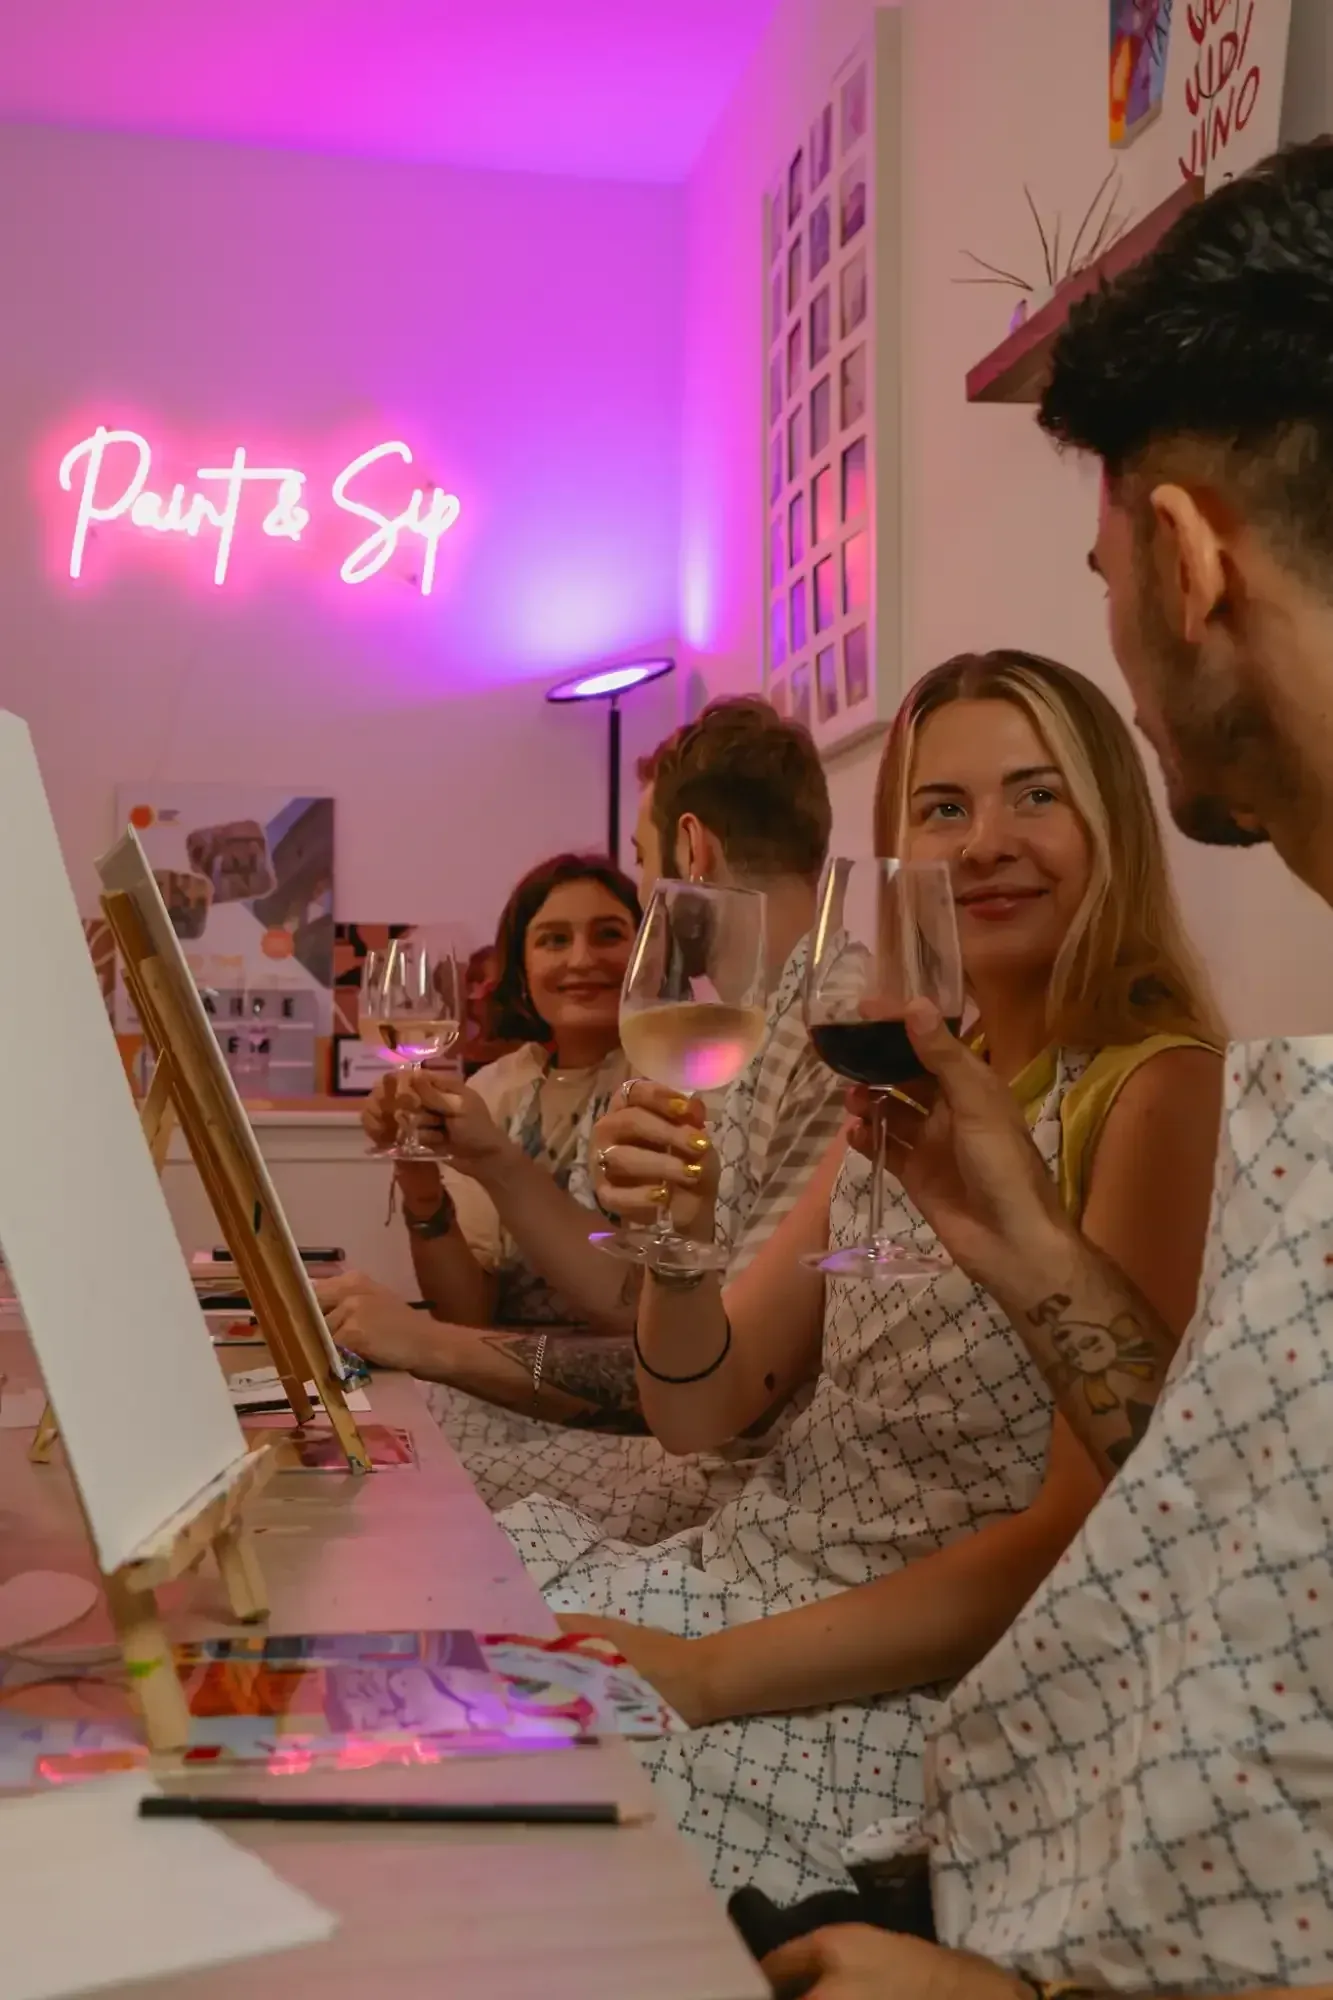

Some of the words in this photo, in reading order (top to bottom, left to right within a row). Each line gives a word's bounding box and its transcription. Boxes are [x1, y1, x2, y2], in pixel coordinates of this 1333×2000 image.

[59, 426, 305, 585] Paint
[263, 473, 309, 541] &
[332, 440, 460, 596] Sip
